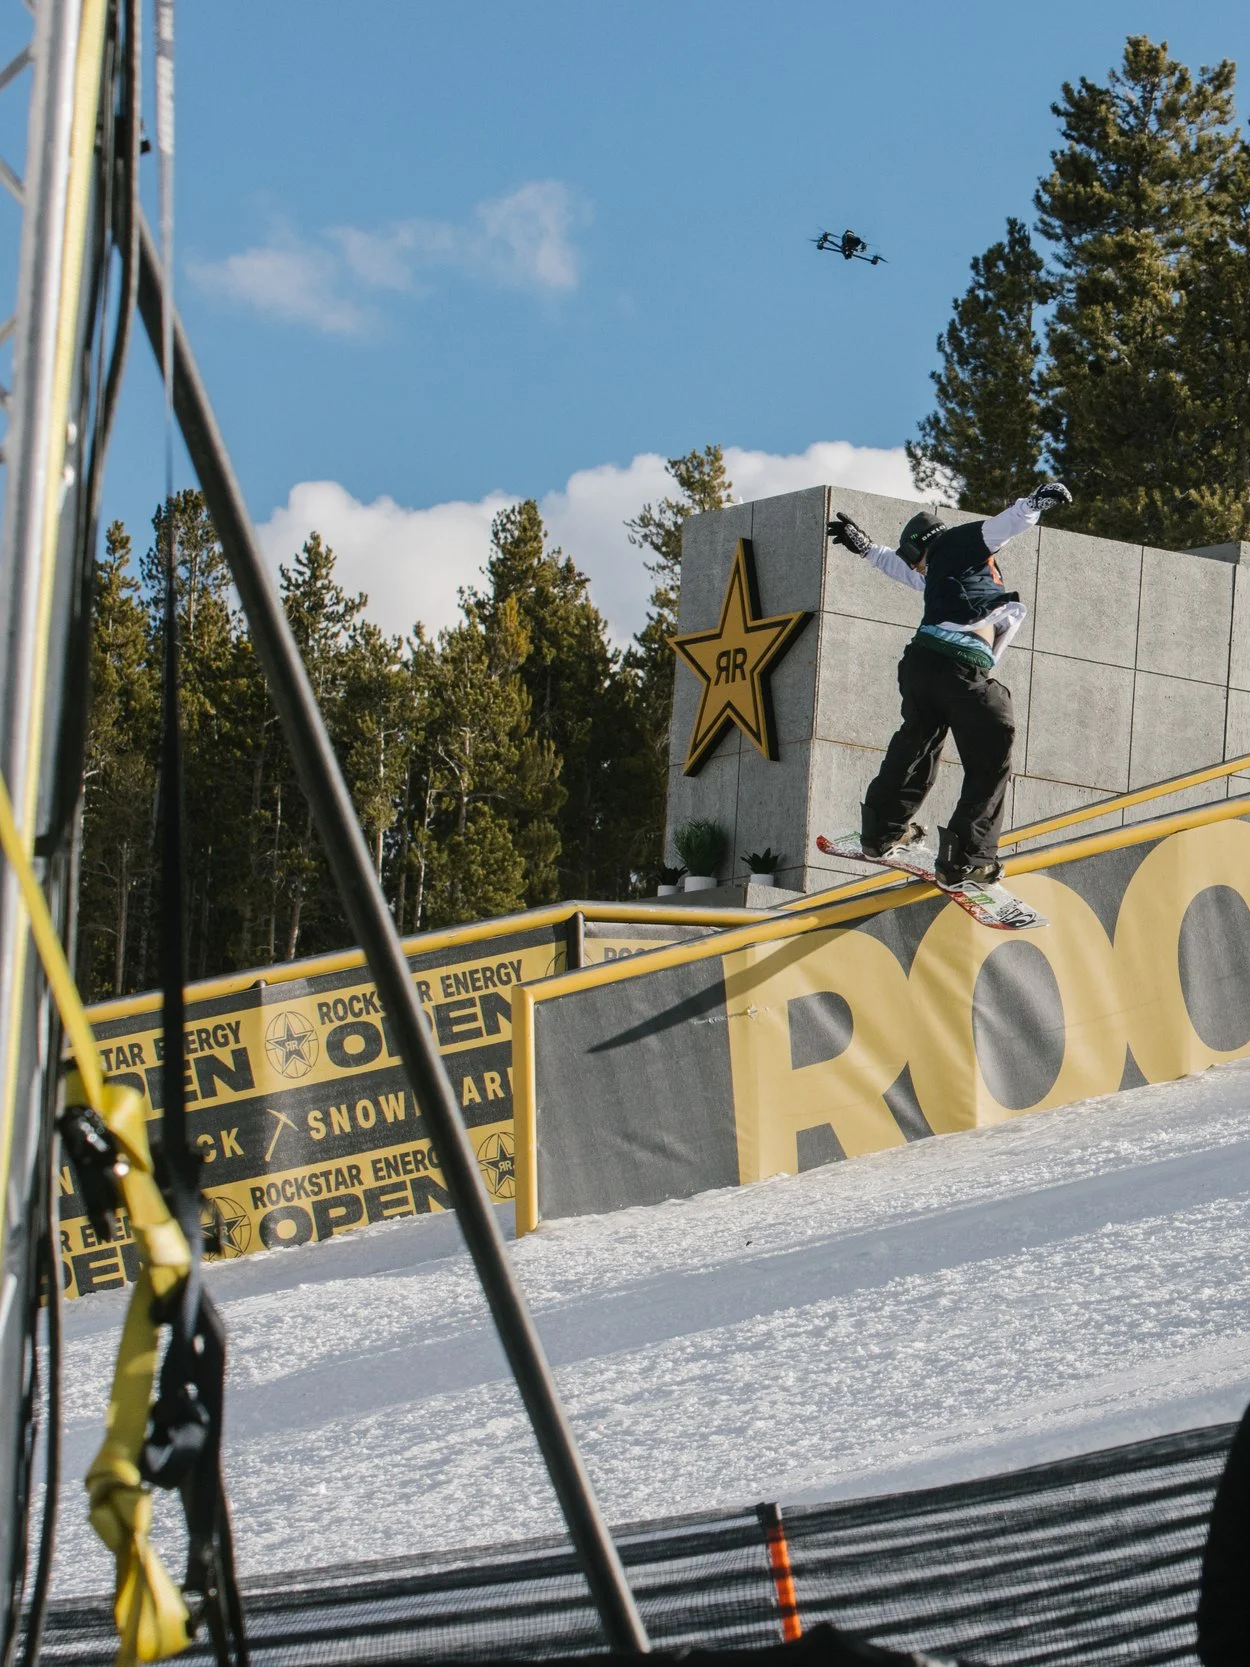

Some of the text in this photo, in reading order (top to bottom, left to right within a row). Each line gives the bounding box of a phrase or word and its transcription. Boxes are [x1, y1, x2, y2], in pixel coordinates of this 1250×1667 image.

[440, 959, 522, 998] ENERGY
[153, 1020, 242, 1061] EERGY
[307, 1066, 513, 1140] SNOWAR
[250, 1165, 363, 1210] ROCKSTAR
